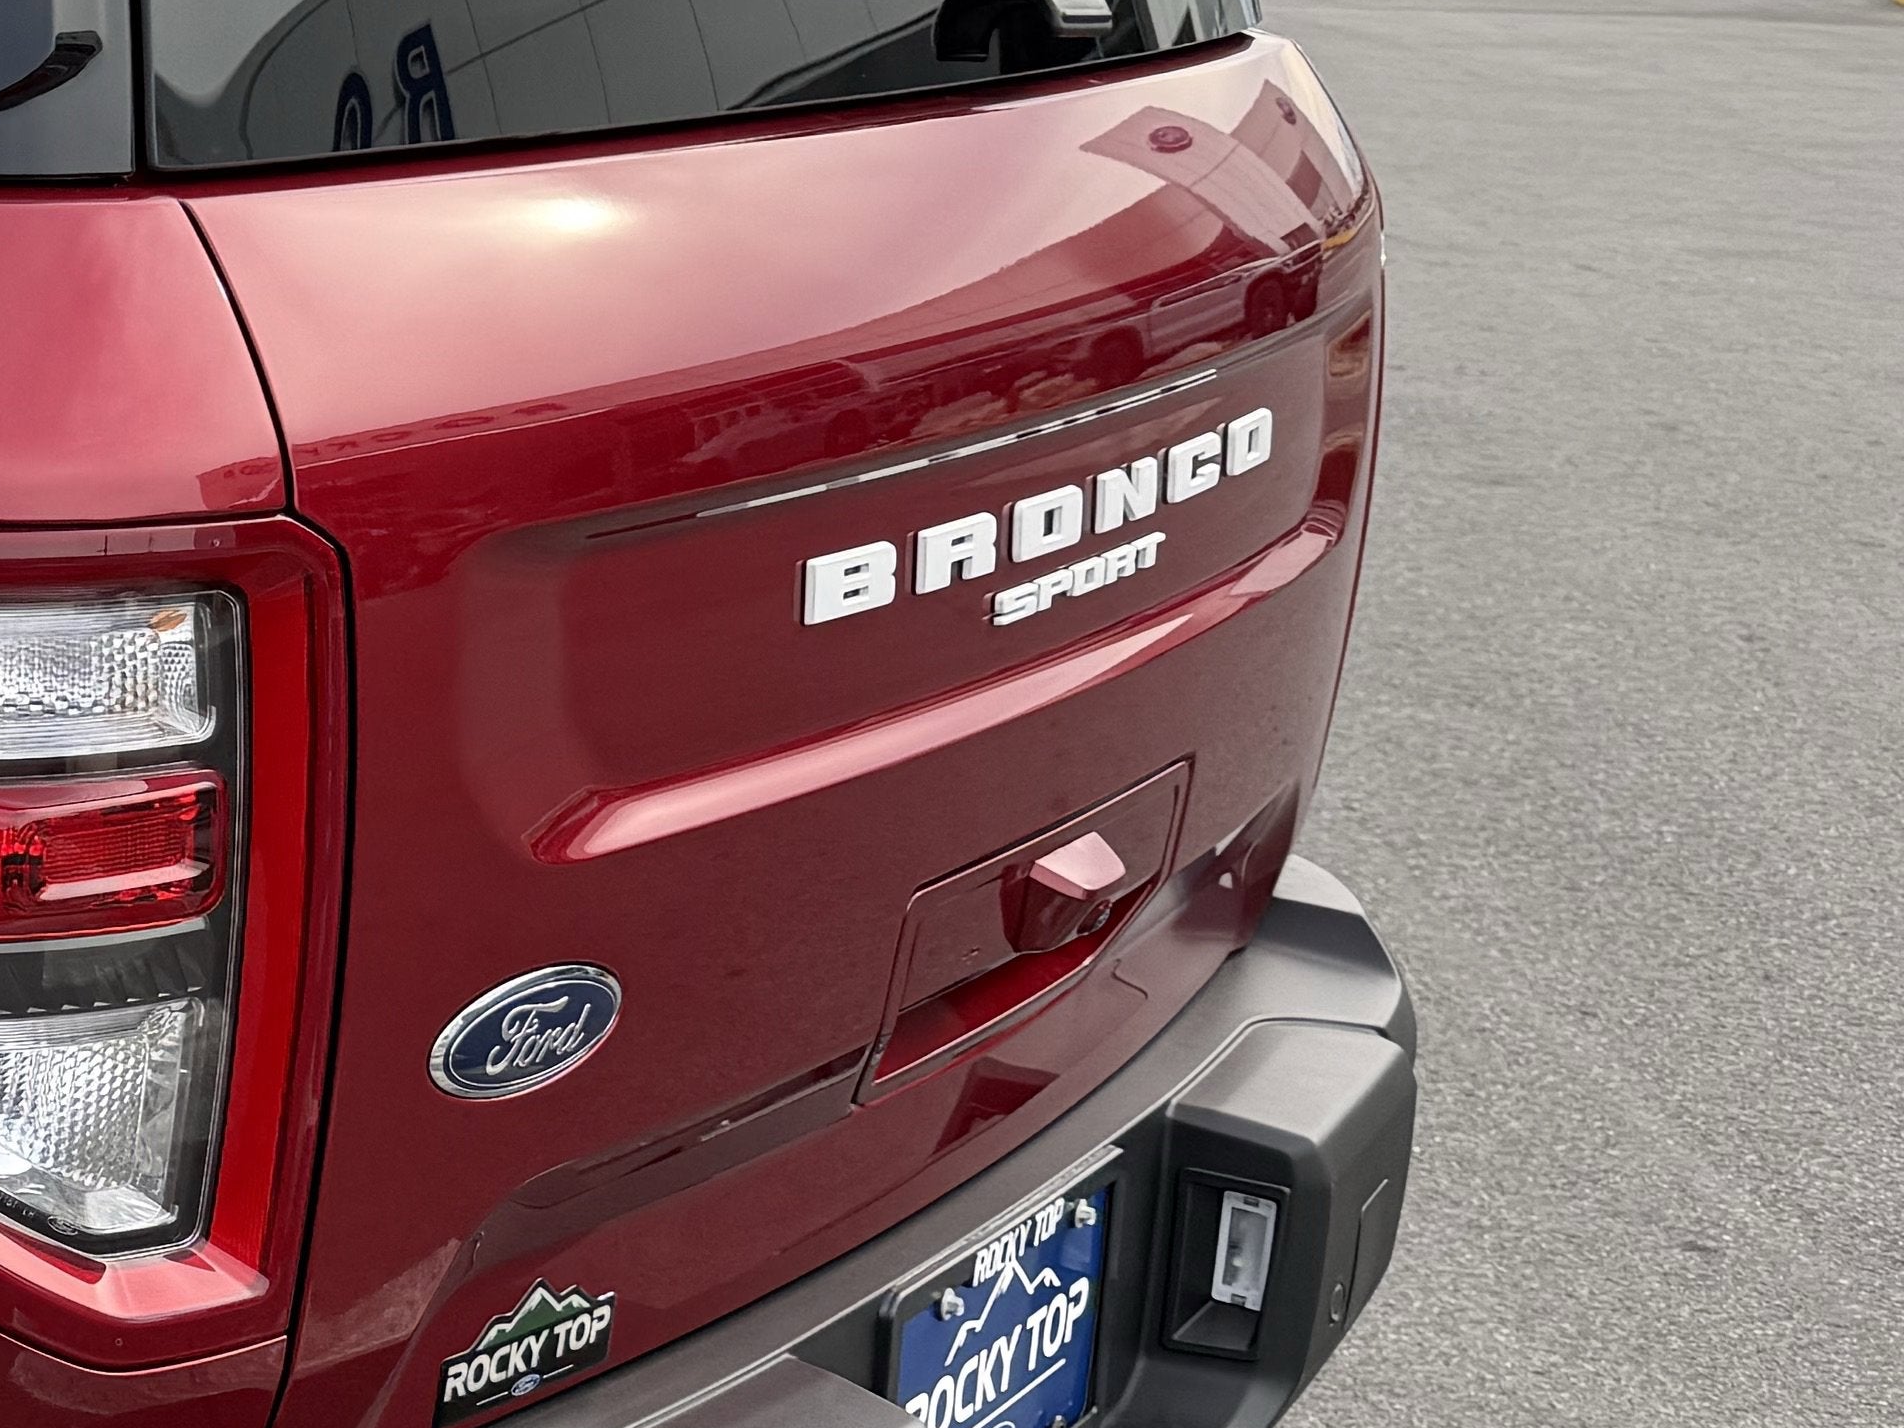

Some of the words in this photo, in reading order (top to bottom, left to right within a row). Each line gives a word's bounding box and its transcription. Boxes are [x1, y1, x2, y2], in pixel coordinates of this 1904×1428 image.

[803, 406, 1273, 626] BRONCO
[992, 531, 1167, 627] SPORT
[485, 996, 591, 1076] Ford
[972, 1219, 1033, 1287] ROCKY
[1035, 1197, 1065, 1247] TOP
[442, 1334, 551, 1403] ROCKY
[553, 1303, 613, 1358] TOP
[1026, 1276, 1090, 1371] TOP
